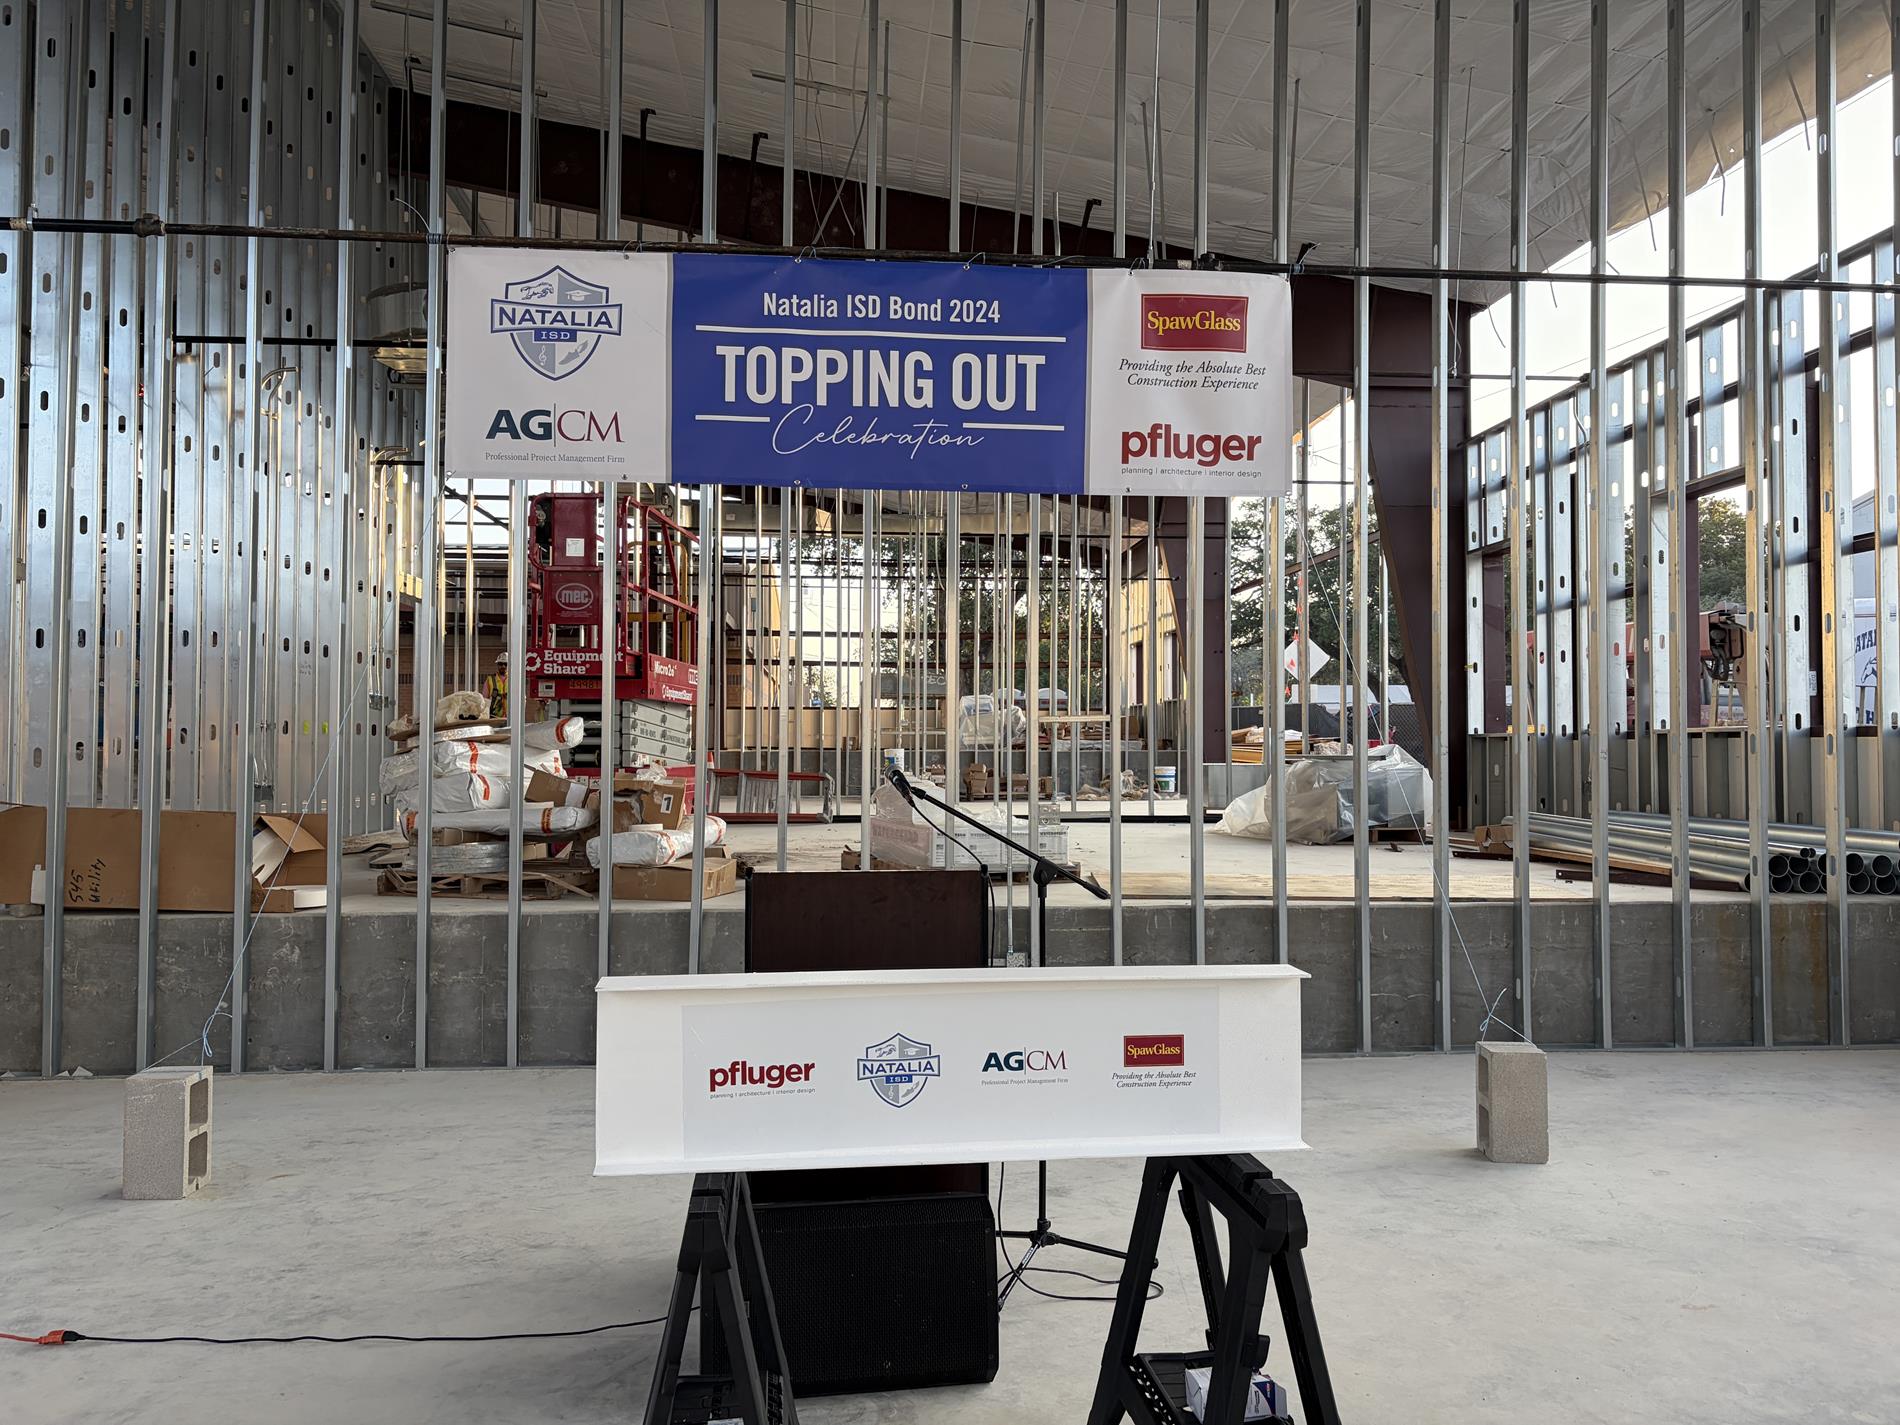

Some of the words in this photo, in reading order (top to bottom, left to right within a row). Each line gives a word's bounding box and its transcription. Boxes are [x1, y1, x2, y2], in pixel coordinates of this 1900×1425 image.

[763, 292, 838, 318] Natalia
[847, 295, 881, 320] ISD
[889, 296, 942, 322] Bond
[949, 299, 1000, 323] 2024
[499, 306, 613, 328] NATALIA
[1147, 311, 1241, 336] SpawGlass
[540, 331, 570, 340] ISD
[1118, 359, 1173, 376] Providing
[1175, 361, 1193, 374] the
[1195, 361, 1242, 375] Absolute
[1245, 363, 1266, 376] Best
[715, 345, 934, 409] TOPPING
[952, 353, 1046, 412] OUT
[1127, 373, 1198, 389] Construction
[1200, 376, 1259, 392] Experience
[772, 404, 985, 460] Celebration
[1121, 423, 1262, 468] pfluger
[485, 452, 530, 462] Professional
[530, 453, 557, 464] Project
[558, 454, 605, 464] Management
[606, 455, 625, 463] Firm
[1121, 467, 1153, 476] planning
[1160, 467, 1202, 476] architecture
[1208, 469, 1234, 477] interior
[1237, 470, 1262, 479] design
[544, 663, 586, 675] Share
[1127, 1043, 1181, 1058] SpawGlass
[862, 1060, 935, 1076] NATALIA
[1112, 1072, 1143, 1081] Providing
[1155, 1071, 1182, 1079] Absolute
[1183, 1070, 1197, 1078] Best
[709, 1060, 816, 1093] pfluger
[1116, 1080, 1157, 1089] Construction
[1158, 1079, 1192, 1088] Experience
[710, 1091, 734, 1099] planning
[738, 1090, 771, 1098] architecture
[796, 1088, 816, 1096] design
